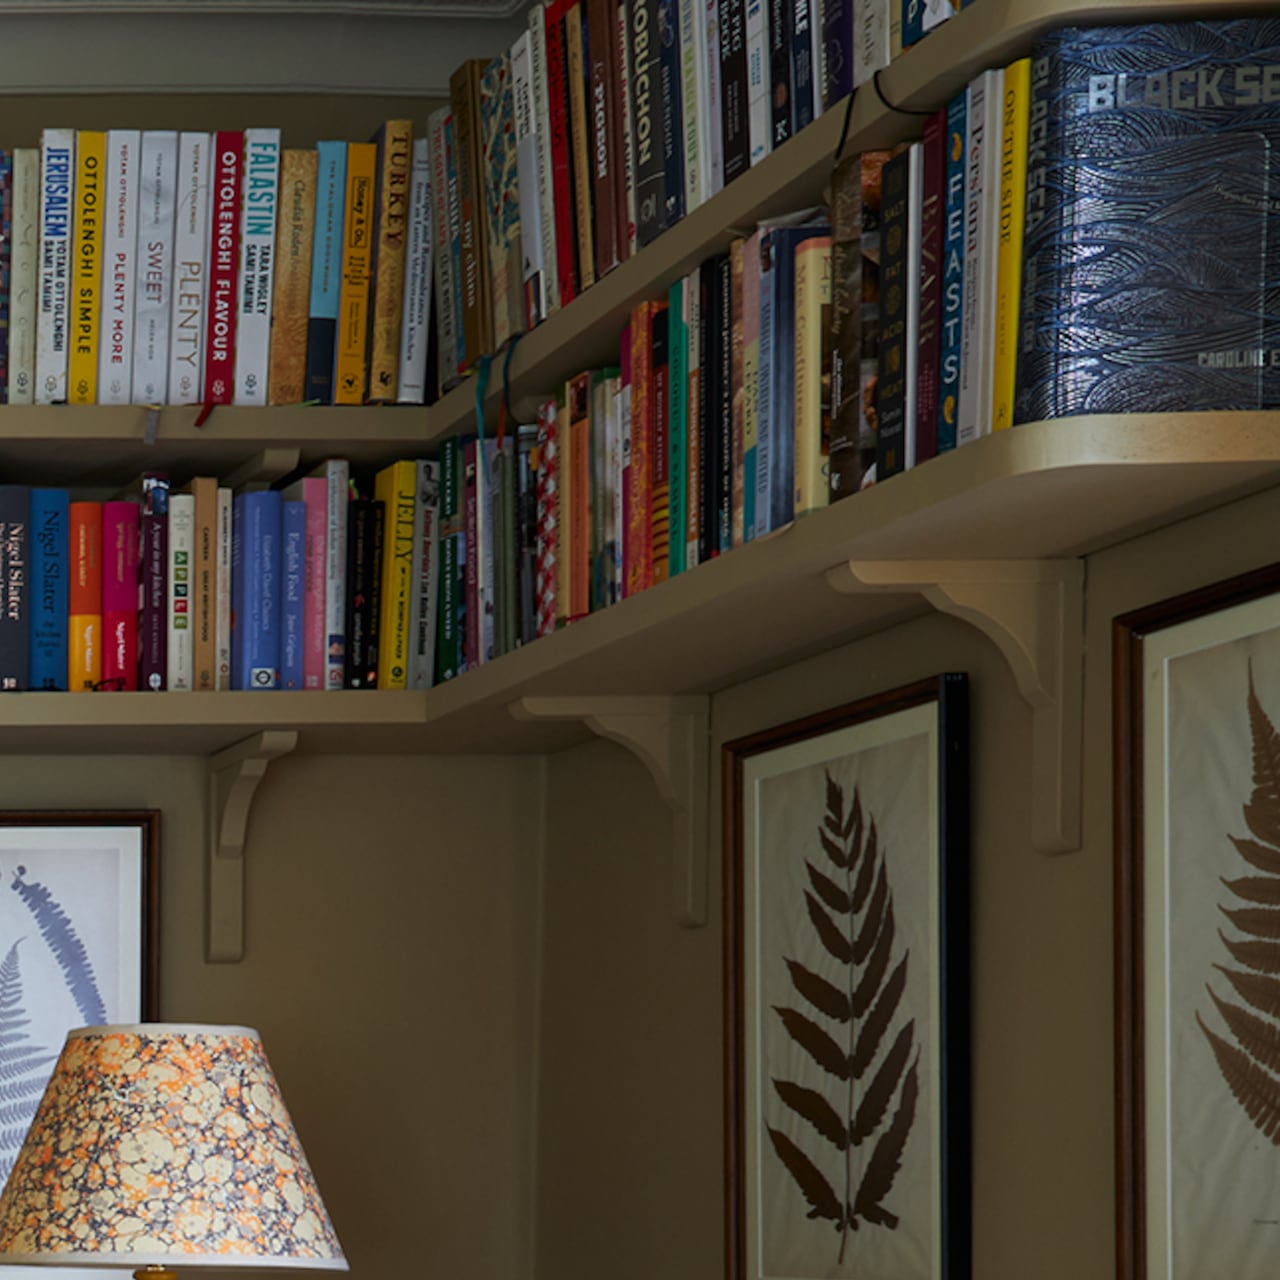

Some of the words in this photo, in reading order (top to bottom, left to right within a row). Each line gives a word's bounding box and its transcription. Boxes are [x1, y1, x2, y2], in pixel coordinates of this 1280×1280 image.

[660, 65, 673, 159] BIBENDUM
[1003, 90, 1017, 126] ON
[1028, 56, 1051, 161] BLACK
[120, 144, 129, 175] YOTAM
[1002, 130, 1017, 187] THE
[44, 146, 70, 236] JERUSALEM
[80, 156, 98, 278] OTTOLENGHI
[118, 178, 128, 239] OTTOLENGHI
[217, 151, 236, 270] OTTOLENGHI
[246, 142, 278, 236] FALASTIN
[292, 180, 306, 222] Claudia
[386, 132, 408, 245] TURKEY
[966, 124, 986, 254] Persiana
[1024, 167, 1047, 236] SEA
[290, 224, 304, 258] Roden
[1000, 190, 1015, 248] SIDE
[56, 240, 67, 279] YOTAM
[112, 252, 128, 314] PLENTY
[146, 242, 163, 304] SWEET
[258, 244, 271, 273] TARA
[794, 263, 808, 311] Mes
[942, 172, 964, 386] FEASTS
[52, 282, 65, 352] OTTOLENGHI
[78, 288, 92, 354] SIMPLE
[177, 261, 202, 368] PLENTY
[212, 279, 231, 362] FLAVOUR
[255, 274, 270, 316] WIGLEY
[110, 319, 124, 364] MORE
[1197, 352, 1268, 369] CAROLINE
[744, 361, 753, 436] LEPARD
[795, 315, 810, 429] Confitures
[5, 523, 24, 566] Nigel
[38, 510, 62, 558] Nigel
[262, 534, 273, 572] Elizabeth
[285, 532, 300, 572] English
[394, 491, 416, 564] JELLY
[8, 570, 24, 621] Slater
[43, 562, 60, 614] Slater
[174, 551, 188, 630] APPLE
[262, 572, 272, 598] David
[288, 574, 300, 602] Food
[260, 598, 272, 631] Classics
[287, 614, 296, 633] Jane
[286, 634, 297, 668] Grigson
